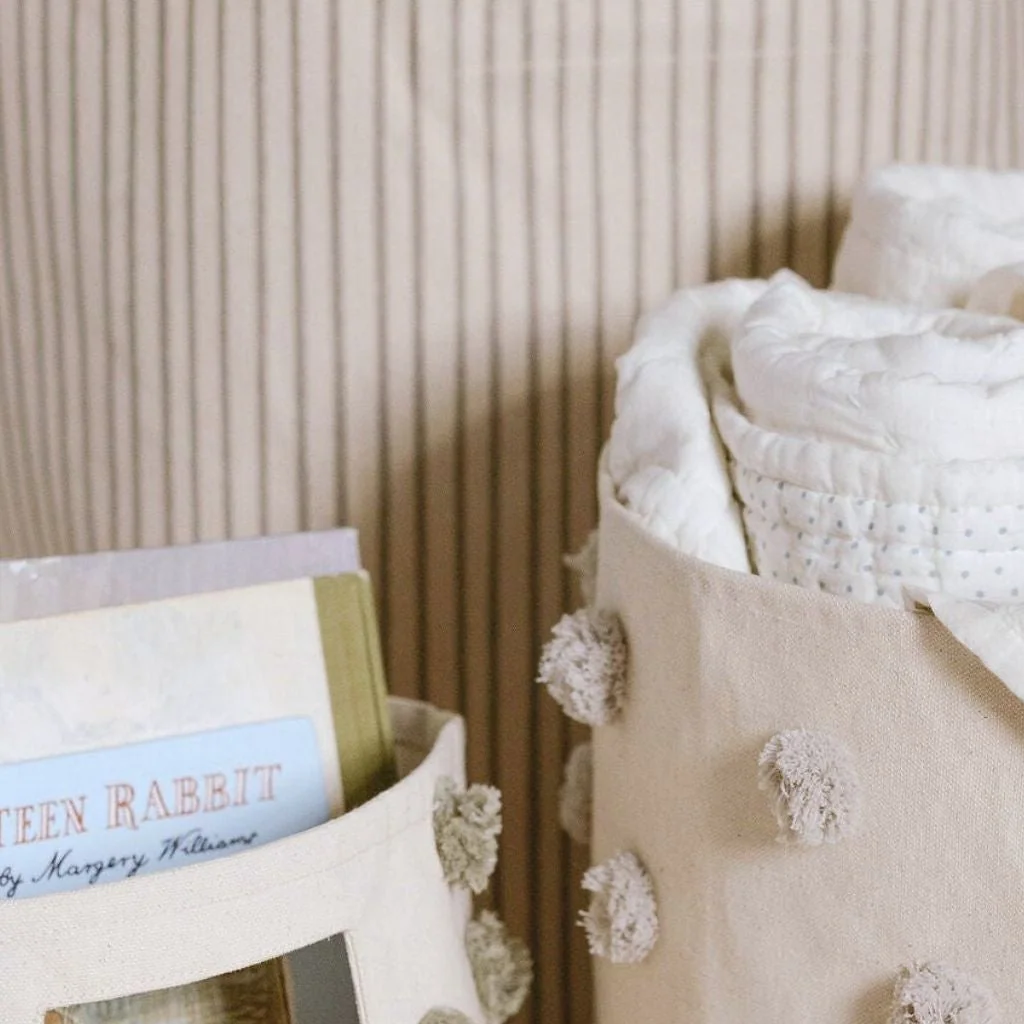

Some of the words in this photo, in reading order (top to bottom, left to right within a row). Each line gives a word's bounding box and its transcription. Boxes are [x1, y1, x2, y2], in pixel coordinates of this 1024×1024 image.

[105, 763, 282, 831] RABBIT
[0, 867, 23, 897] by
[32, 848, 149, 884] Margery
[158, 827, 258, 862] Williams
